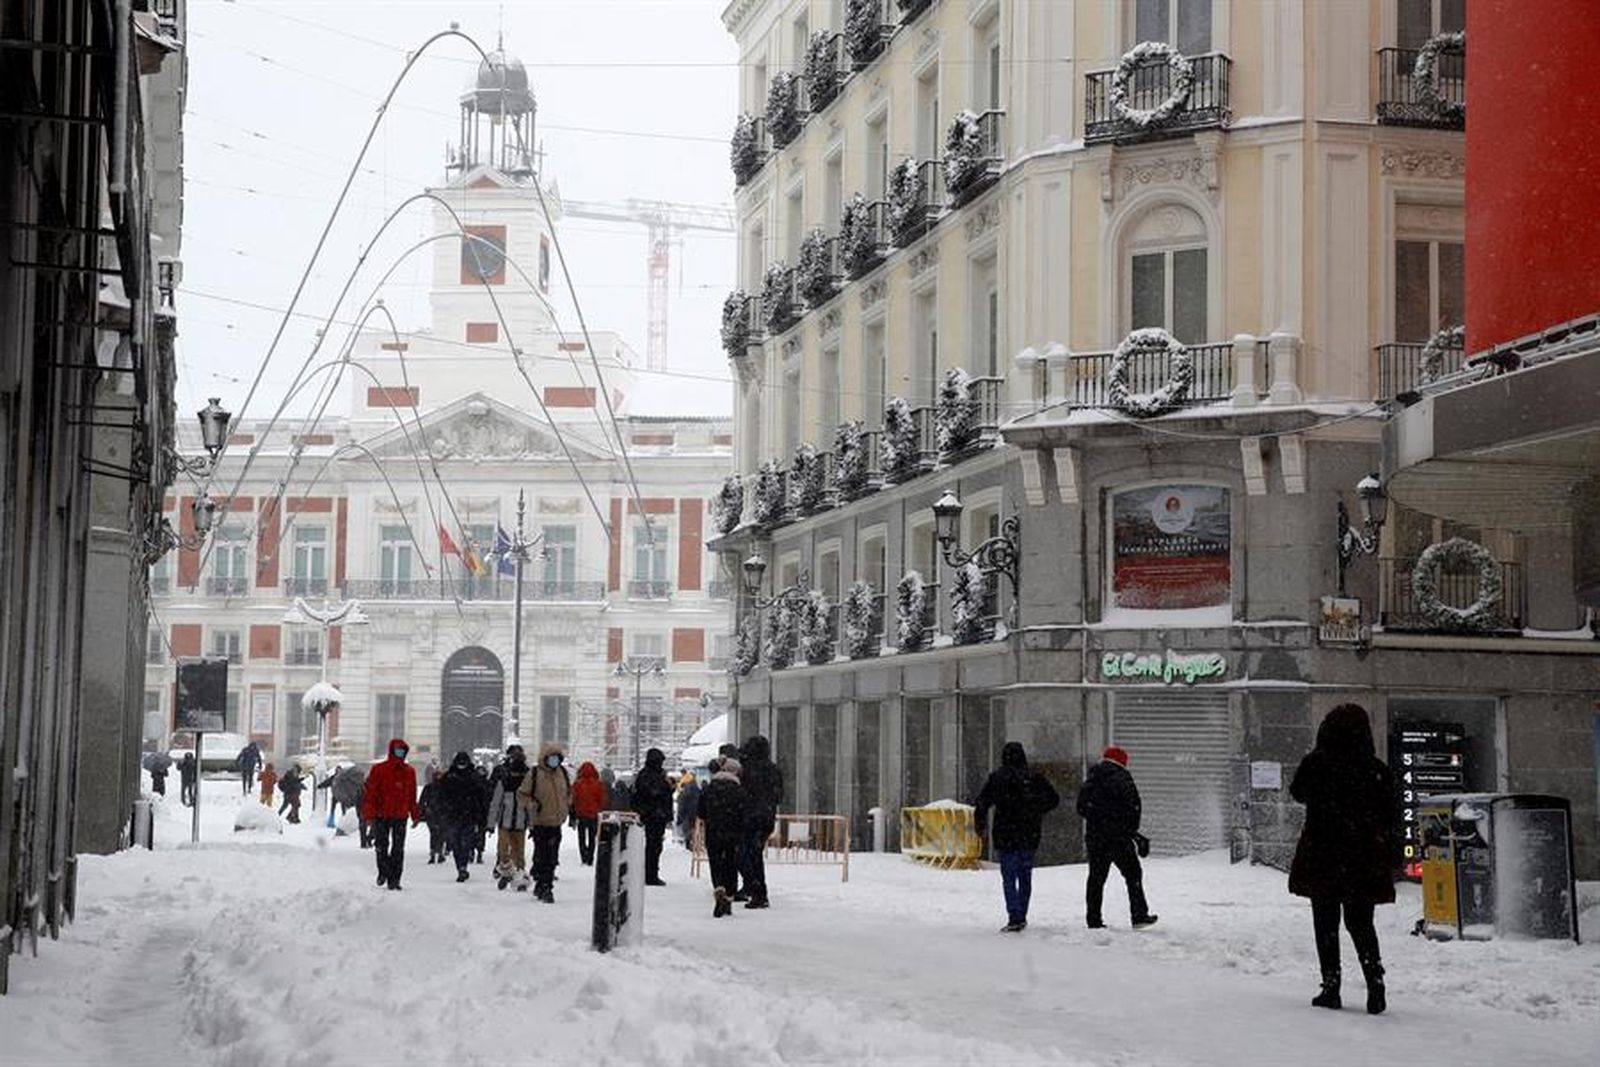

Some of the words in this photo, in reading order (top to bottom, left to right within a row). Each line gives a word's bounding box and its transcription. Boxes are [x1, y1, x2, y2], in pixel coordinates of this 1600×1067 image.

[1102, 652, 1120, 677] El
[1403, 753, 1412, 766] 5
[1403, 771, 1412, 784] 4
[1403, 790, 1412, 803] 3
[1403, 808, 1413, 821] 2
[1405, 826, 1412, 839] 1
[1404, 845, 1414, 858] 0
